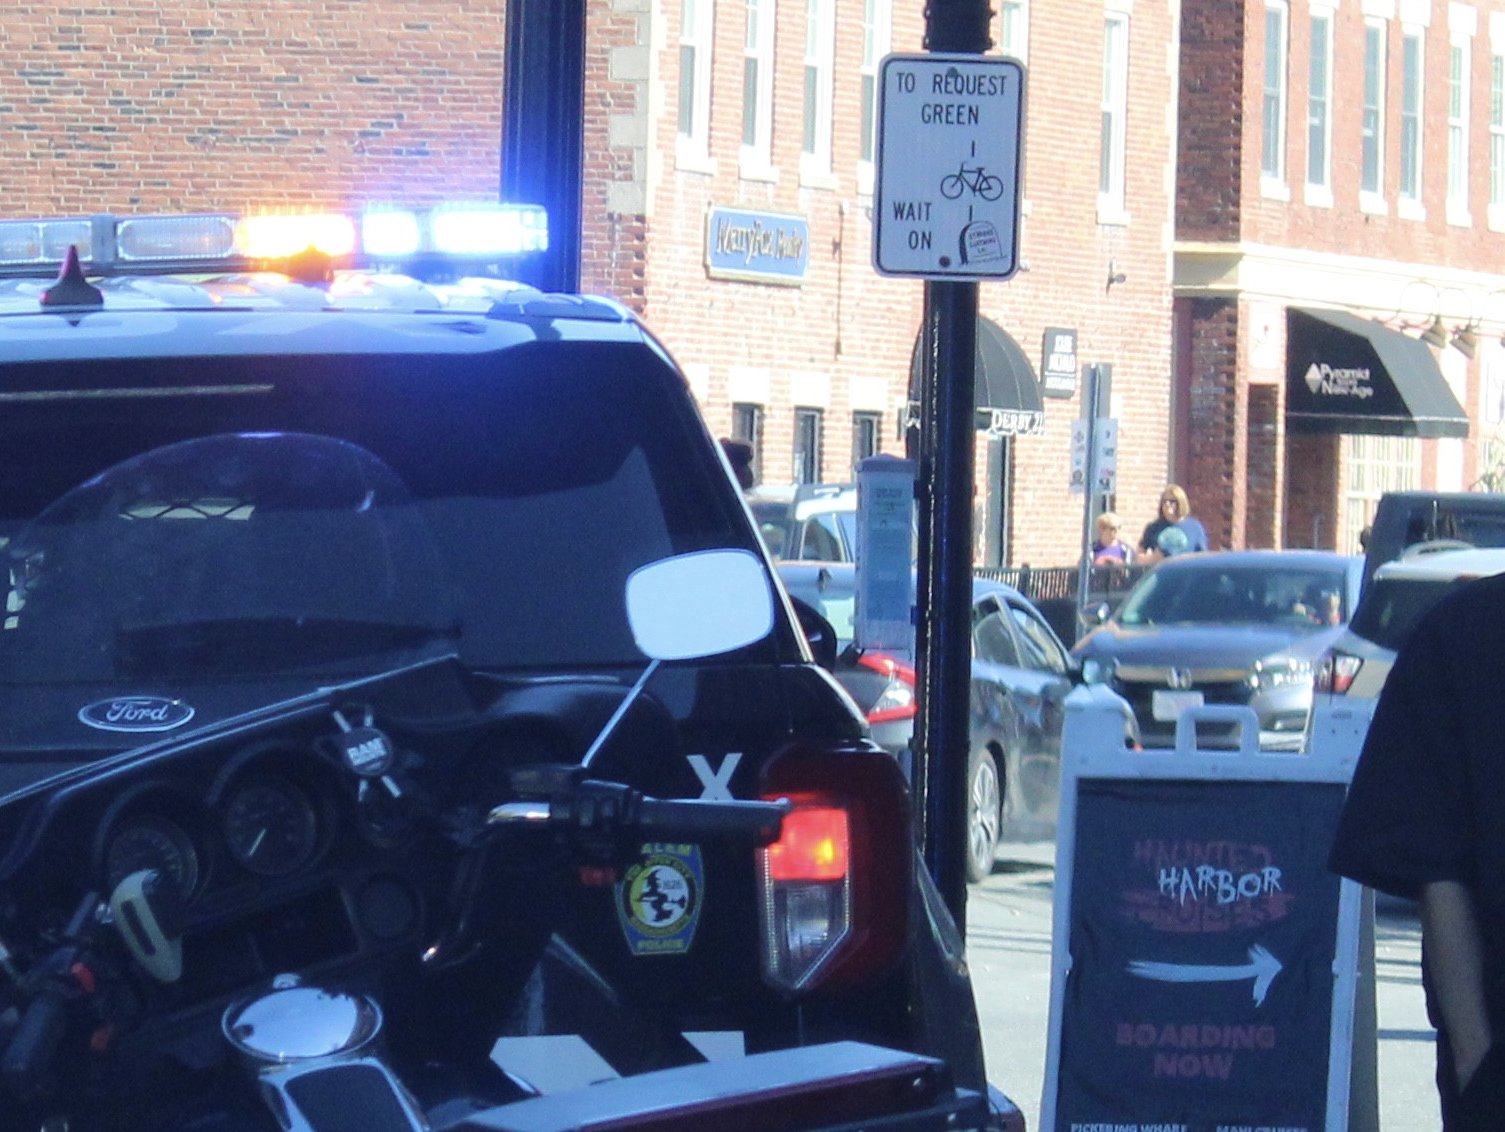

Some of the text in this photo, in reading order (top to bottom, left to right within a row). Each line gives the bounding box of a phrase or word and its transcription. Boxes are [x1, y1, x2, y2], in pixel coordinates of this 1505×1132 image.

[896, 72, 1008, 96] TO REQUEST
[921, 104, 979, 125] GREEN
[893, 201, 932, 221] WAIT
[908, 230, 932, 250] ON
[106, 700, 169, 722] Ford
[1158, 864, 1283, 907] HARBOR
[1116, 1023, 1276, 1050] BOARDING
[1154, 1054, 1234, 1081] NOW
